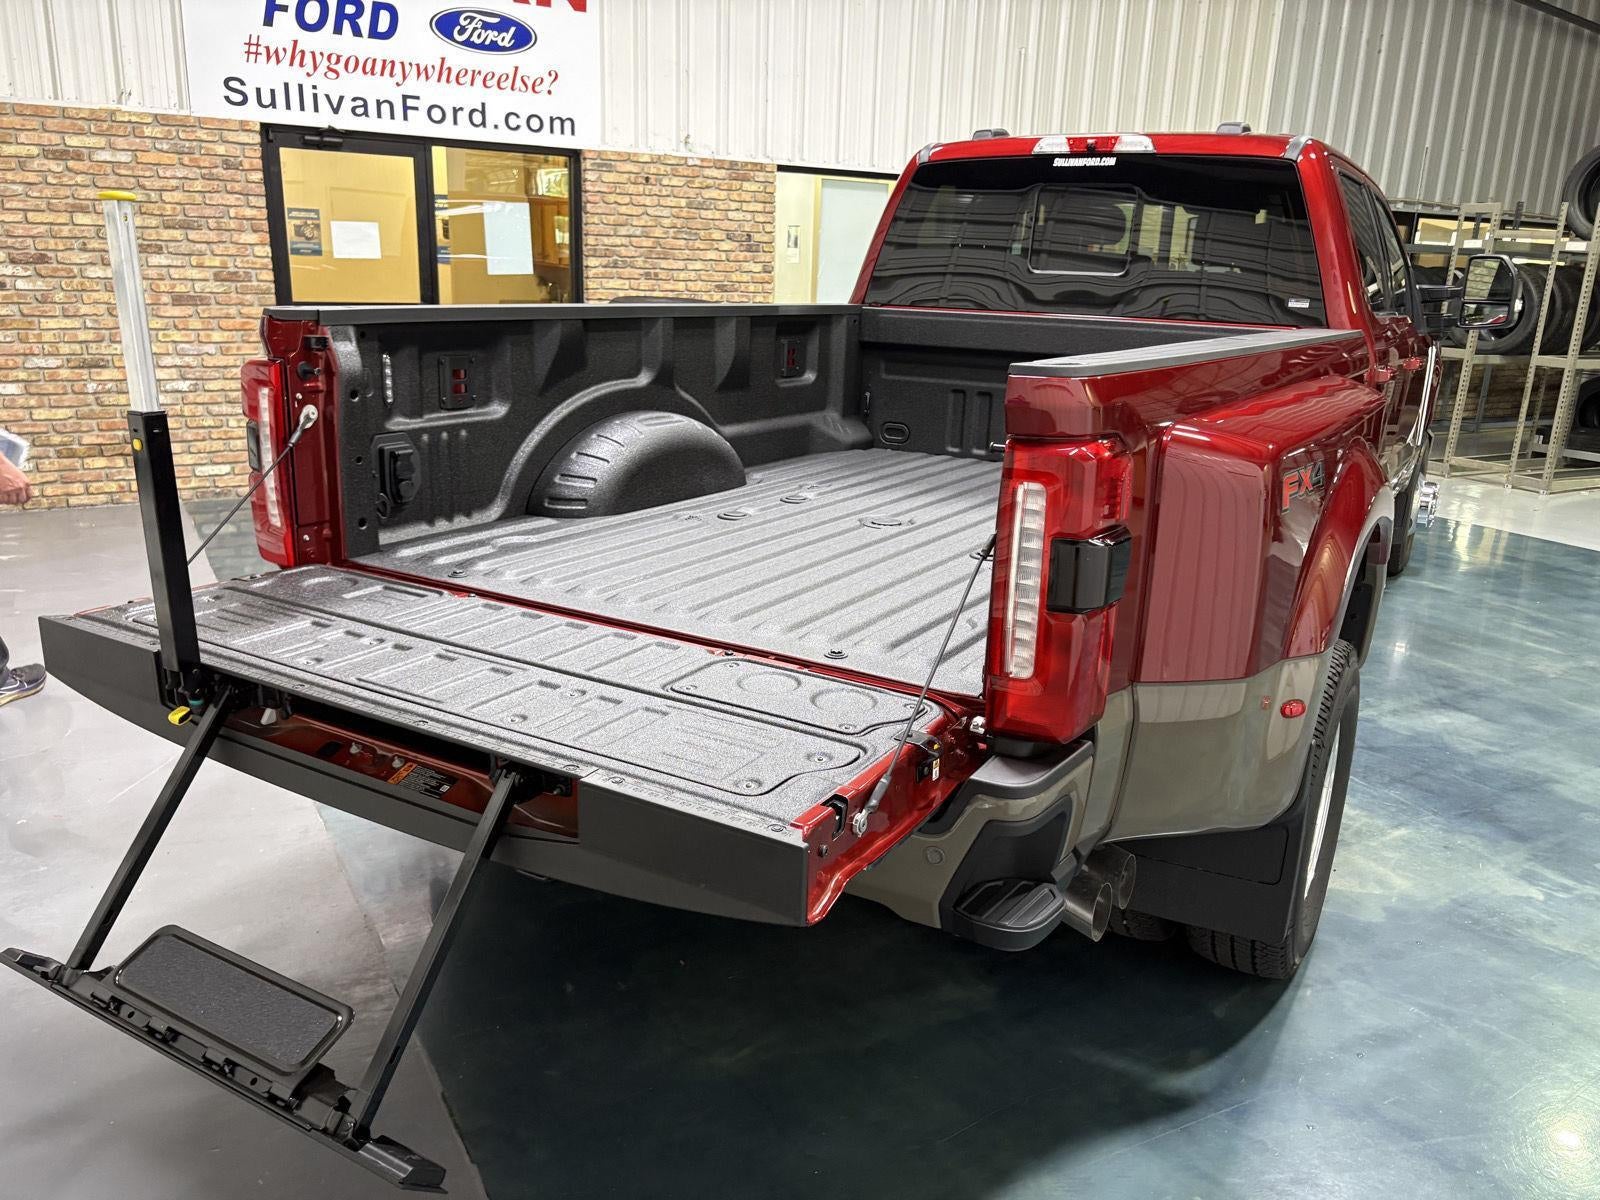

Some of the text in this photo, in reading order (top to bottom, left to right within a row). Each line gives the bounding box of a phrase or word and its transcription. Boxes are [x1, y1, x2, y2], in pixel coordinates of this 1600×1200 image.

[263, 0, 399, 40] FORD
[453, 11, 515, 49] Ford
[243, 34, 559, 96] #whygoanywhereelse?
[222, 76, 577, 136] SullivanFord.com
[1053, 157, 1116, 166] SULLIVANFORD.COM
[1281, 460, 1325, 514] FX4
